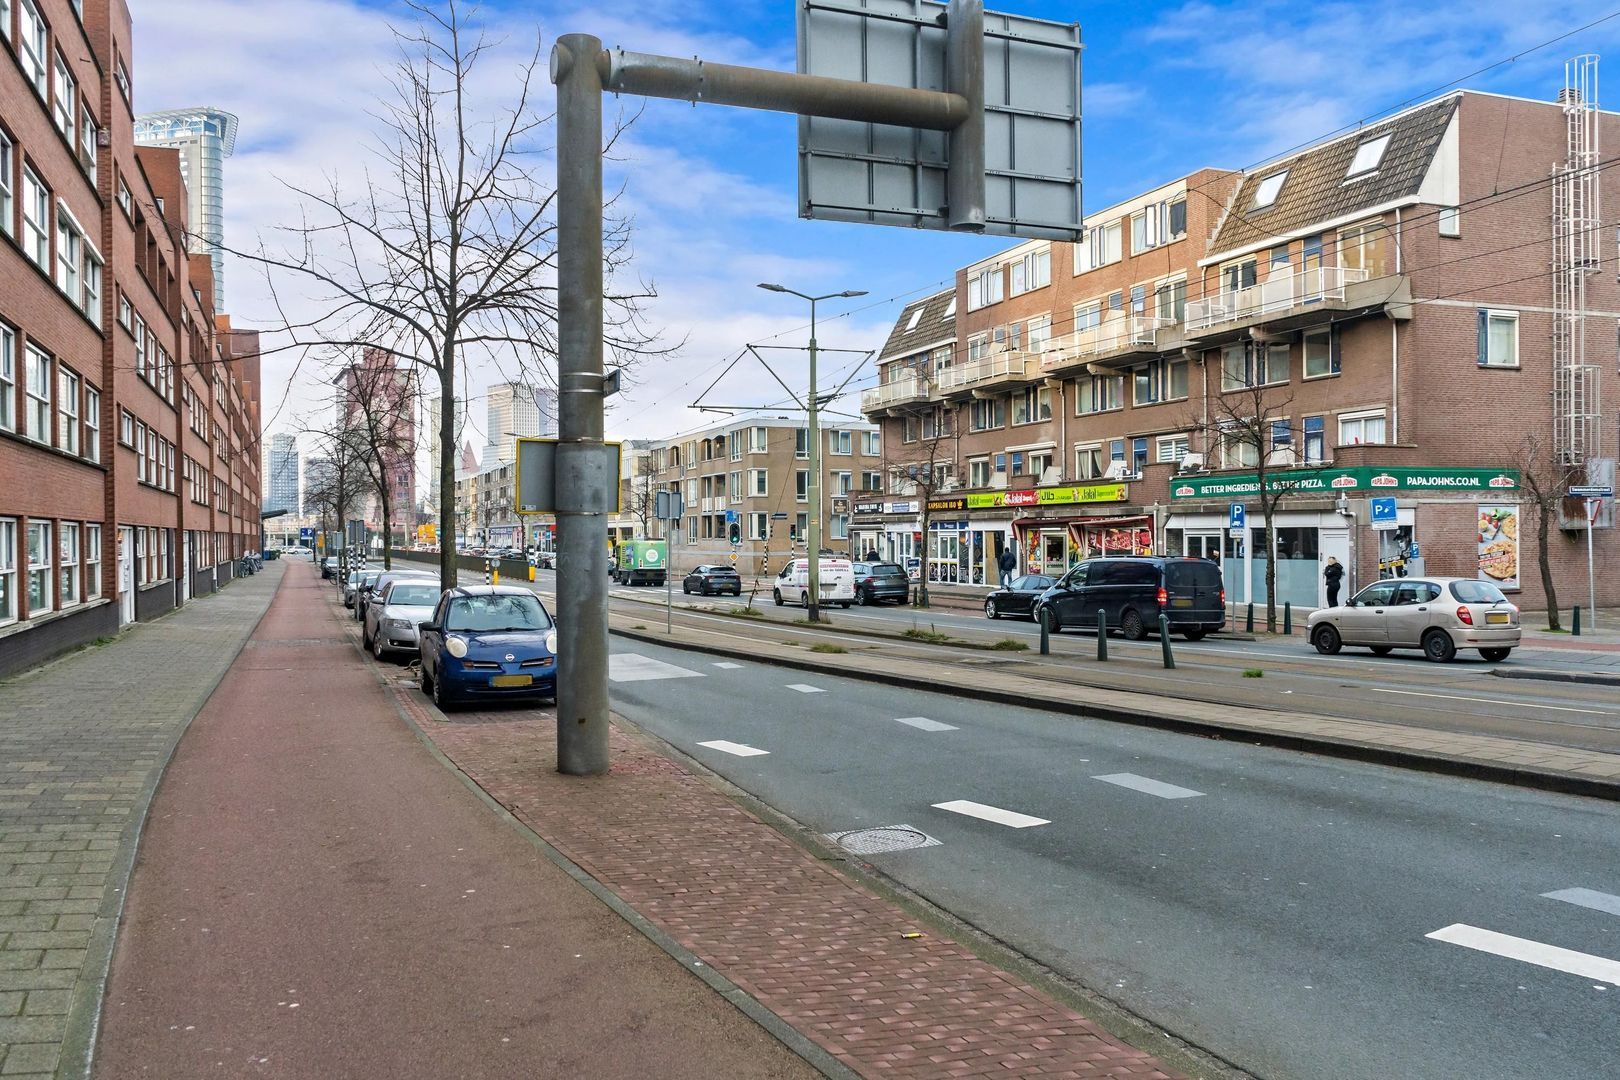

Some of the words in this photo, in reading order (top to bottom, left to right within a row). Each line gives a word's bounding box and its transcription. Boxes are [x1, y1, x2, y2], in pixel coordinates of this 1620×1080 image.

[1201, 484, 1225, 494] BETTER
[1225, 482, 1271, 493] INGREDIENS.
[1301, 479, 1326, 489] PIZZA.
[1407, 476, 1481, 486] PAPAJOHNS.CO.NL
[1234, 505, 1242, 518] P
[1375, 505, 1383, 515] P
